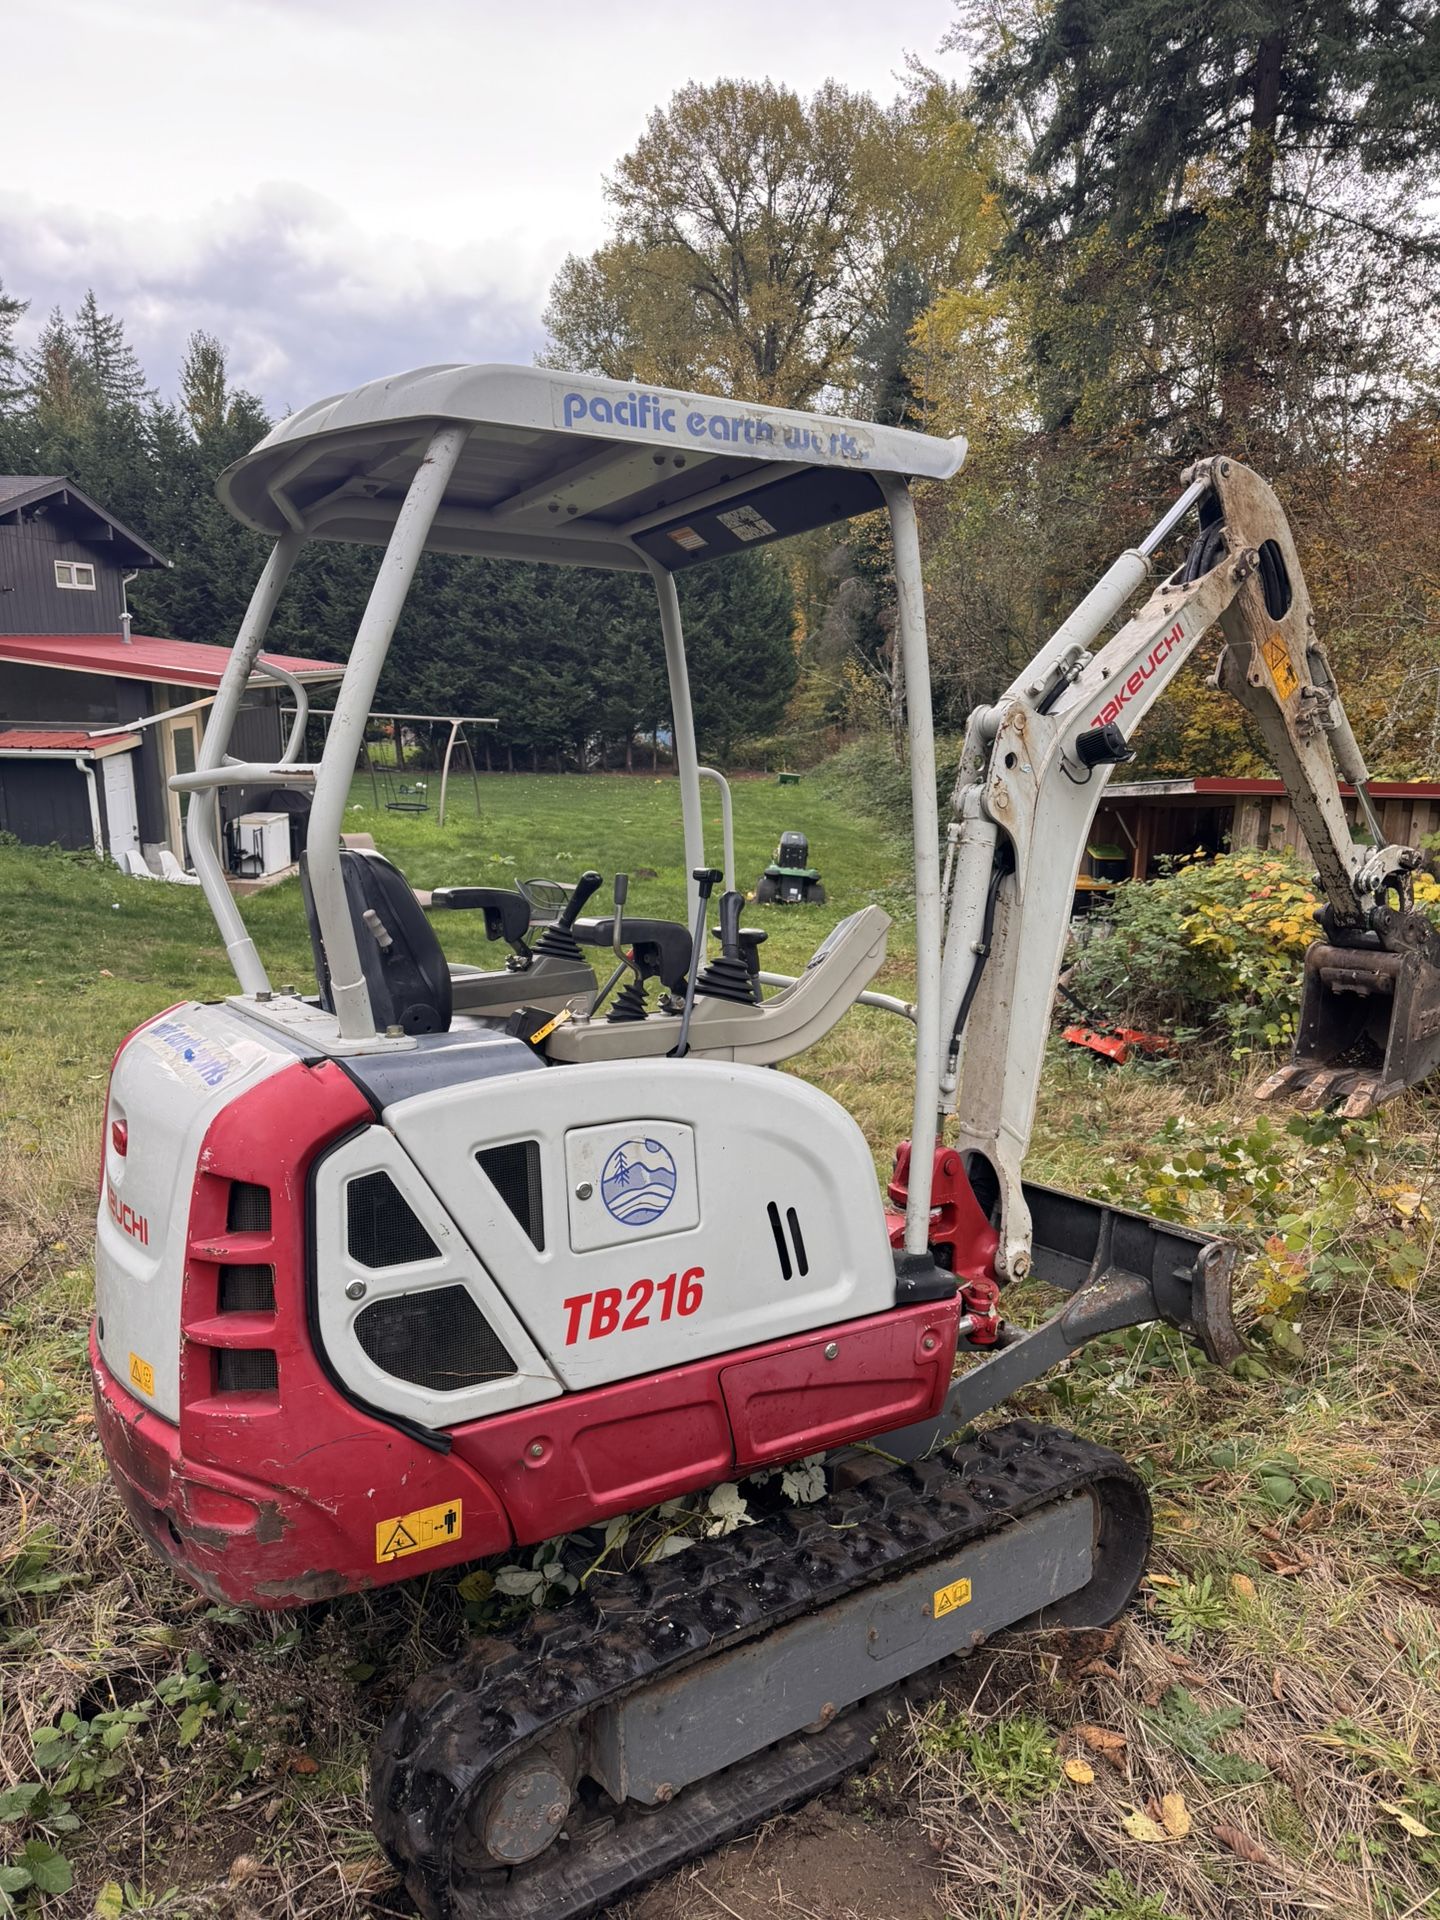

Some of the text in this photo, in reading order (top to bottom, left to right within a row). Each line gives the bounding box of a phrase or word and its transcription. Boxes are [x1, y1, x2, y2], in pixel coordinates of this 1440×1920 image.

[563, 391, 676, 433] pacific
[107, 1186, 149, 1246] EUCHI
[563, 1266, 705, 1346] TB216
